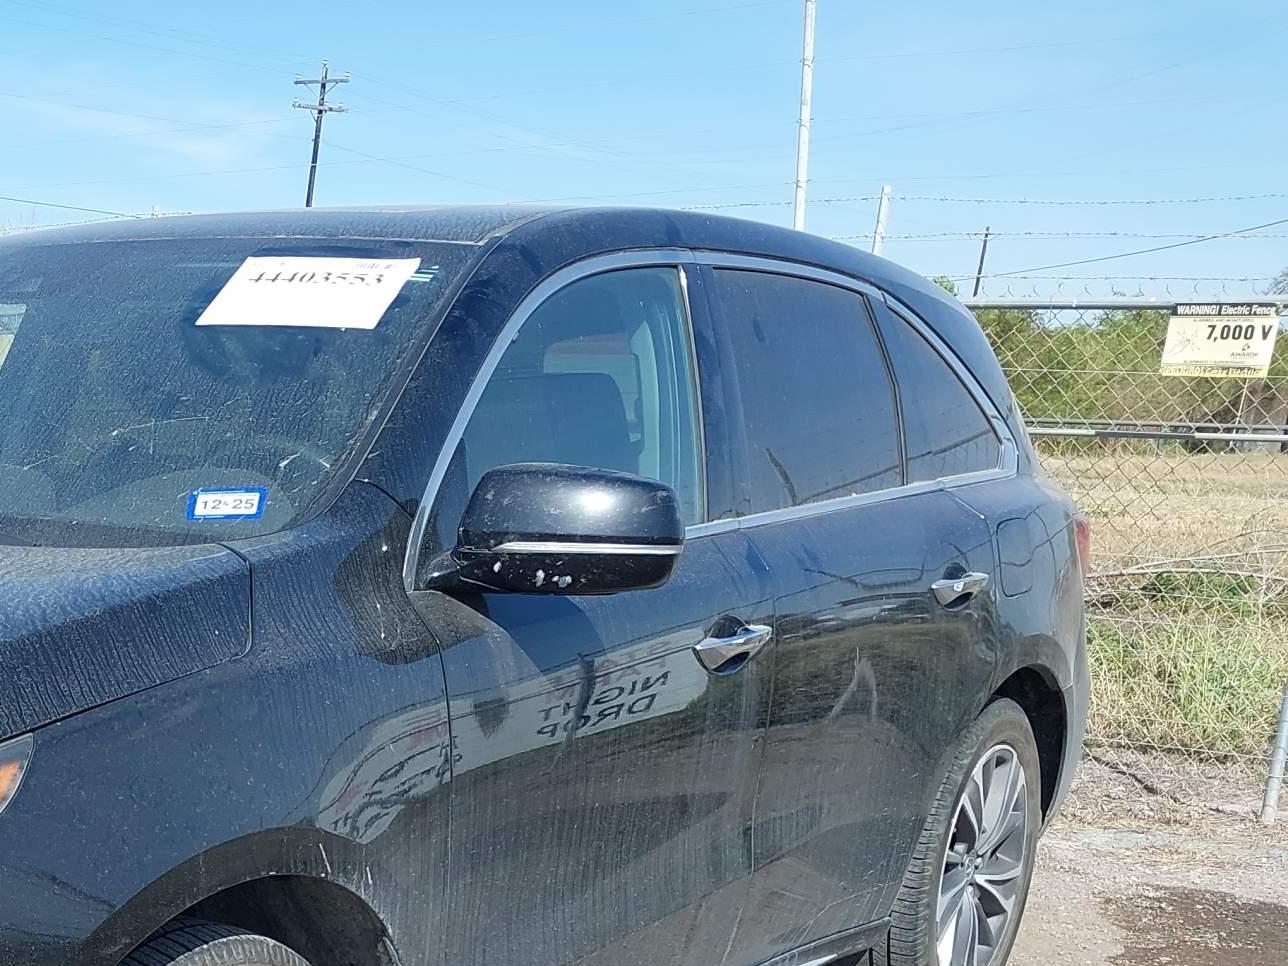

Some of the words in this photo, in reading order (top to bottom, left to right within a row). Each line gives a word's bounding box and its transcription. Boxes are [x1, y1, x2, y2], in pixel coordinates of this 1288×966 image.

[1177, 304, 1220, 315] WARNING!
[1221, 304, 1250, 315] Electric
[1251, 304, 1276, 316] Fence
[1207, 324, 1255, 342] 7,000
[1261, 324, 1273, 341] V
